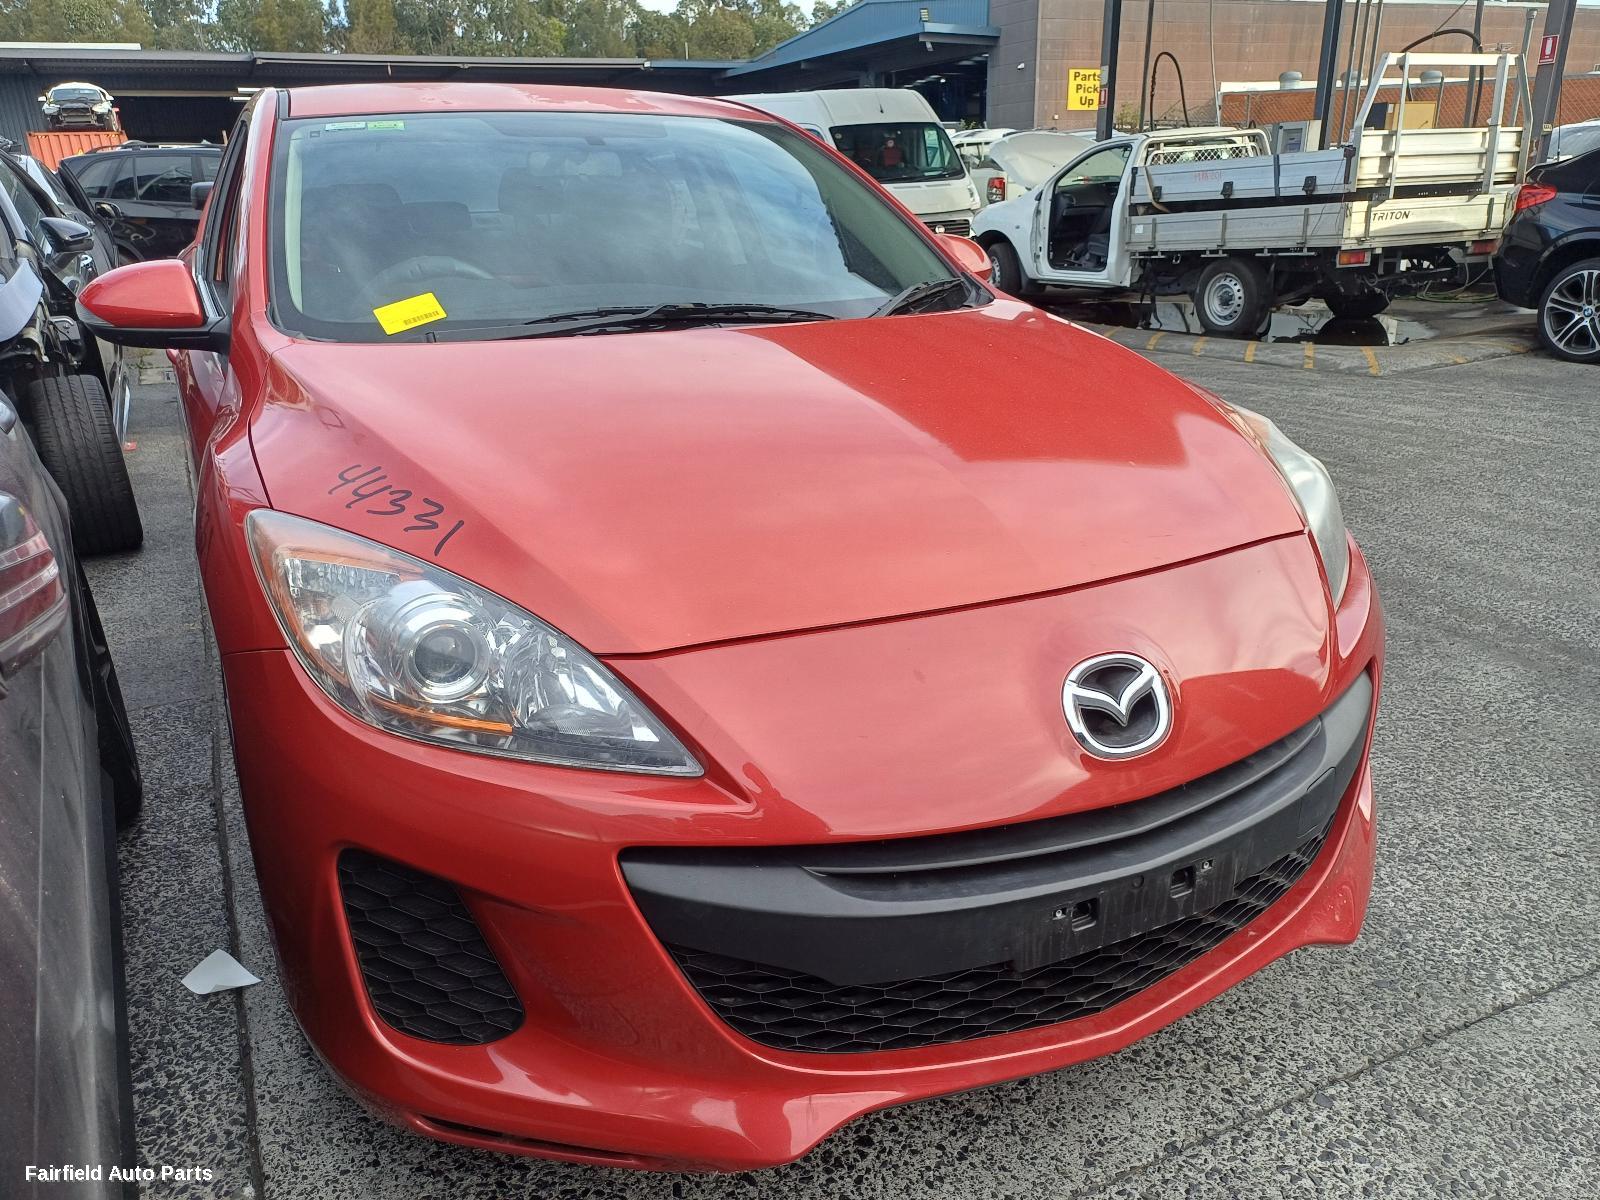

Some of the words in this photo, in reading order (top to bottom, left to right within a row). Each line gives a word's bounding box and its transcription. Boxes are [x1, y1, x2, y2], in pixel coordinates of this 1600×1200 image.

[1073, 71, 1101, 81] Parts
[1076, 84, 1099, 94] Pick
[1079, 96, 1094, 108] Up
[1373, 210, 1410, 221] TRITON
[327, 464, 465, 556] 44331
